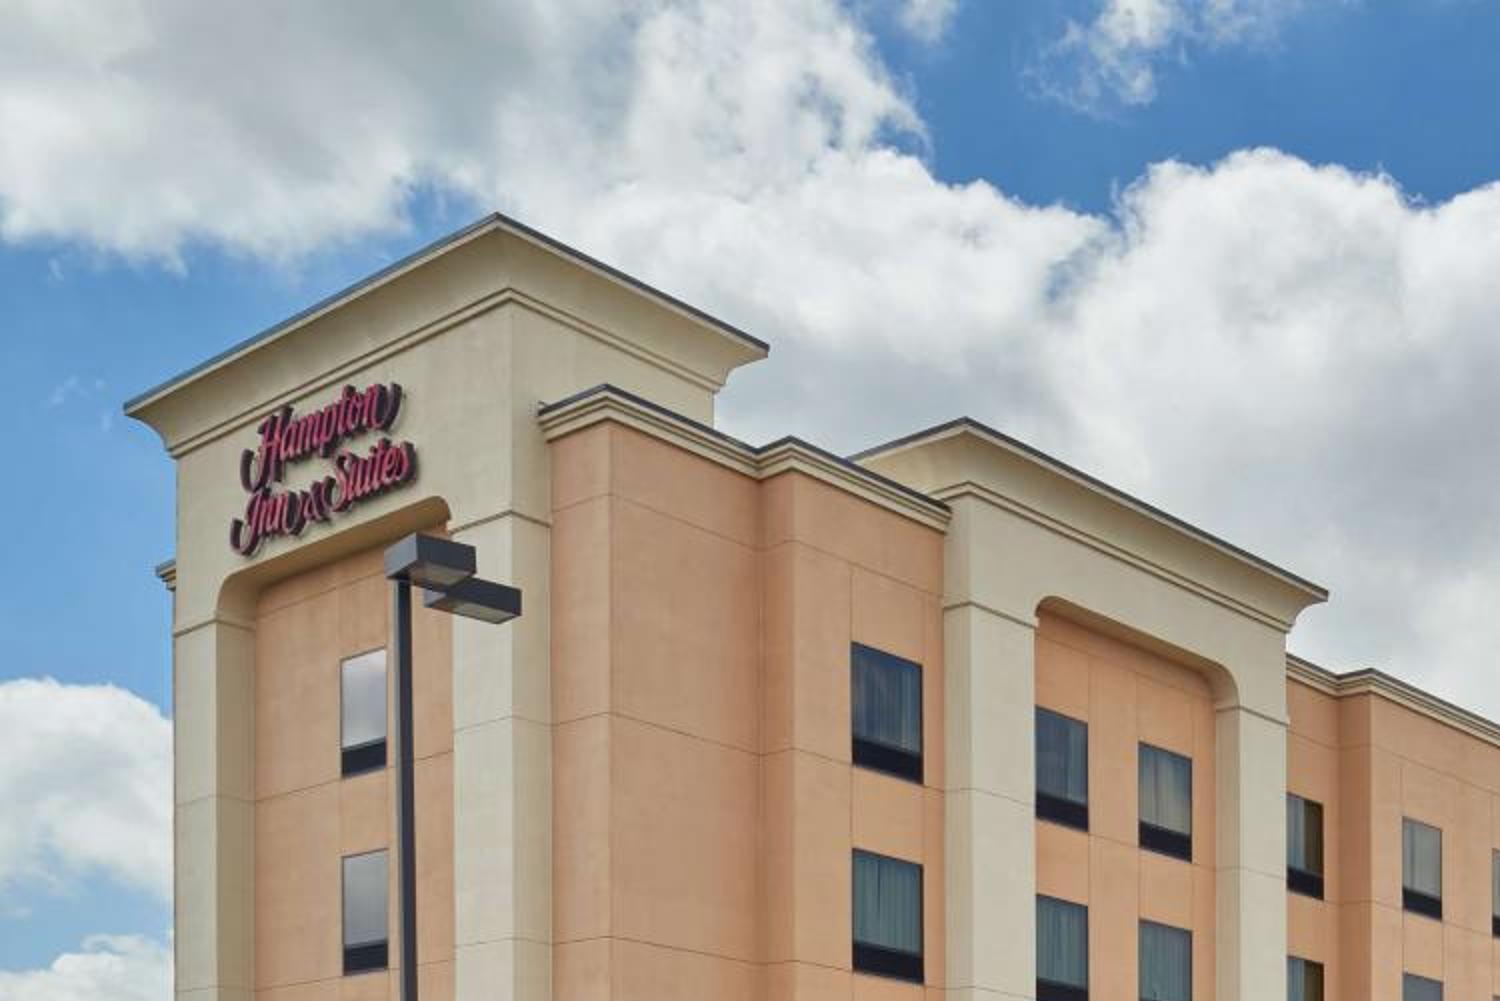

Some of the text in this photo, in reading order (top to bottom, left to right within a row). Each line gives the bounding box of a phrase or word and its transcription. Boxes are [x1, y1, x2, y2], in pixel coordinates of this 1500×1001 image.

[240, 382, 403, 494] Hampton
[230, 487, 307, 556] Inn
[324, 438, 420, 513] Suites
